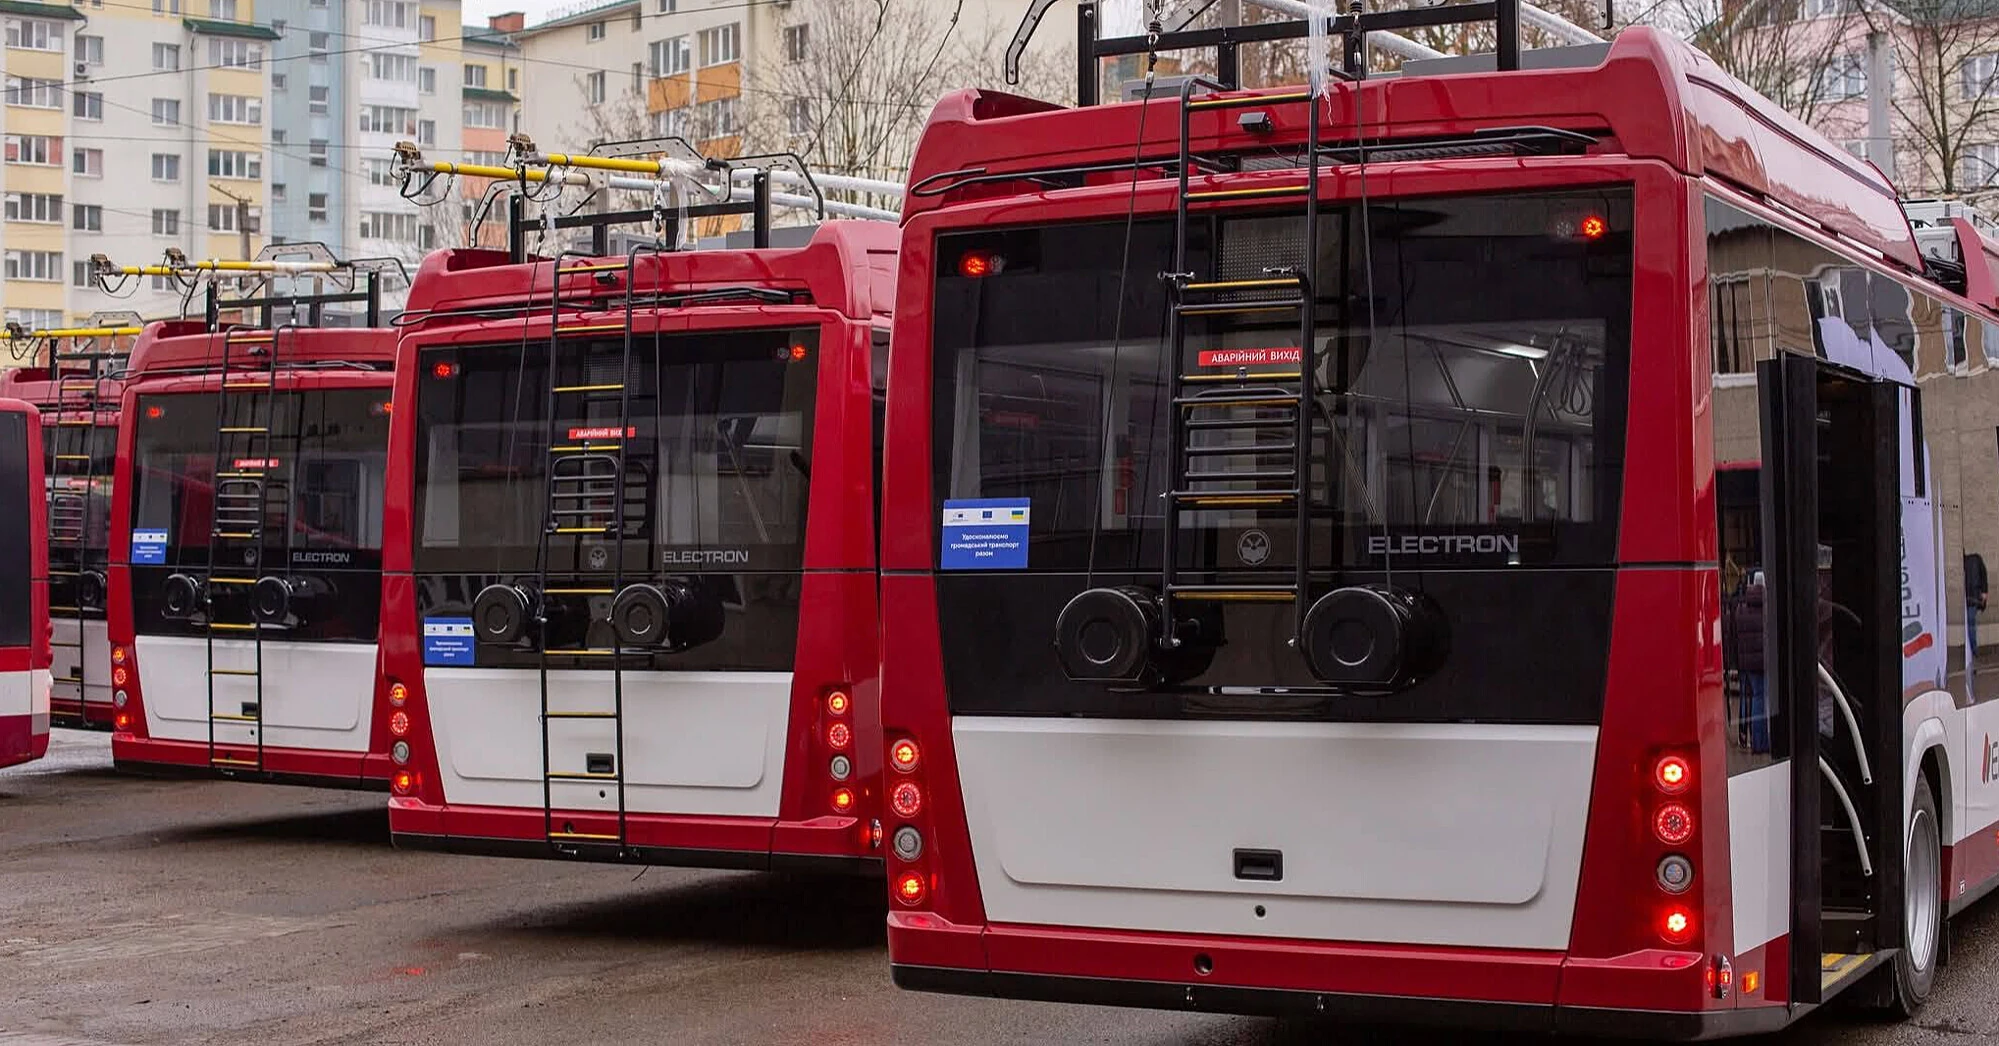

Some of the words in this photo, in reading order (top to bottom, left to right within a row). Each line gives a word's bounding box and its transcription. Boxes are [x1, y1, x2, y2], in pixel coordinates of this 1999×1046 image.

[1211, 349, 1266, 363] АВАРІЙНИЙ
[1270, 350, 1299, 362] ВИХІД
[1368, 534, 1519, 554] ELECTRON
[292, 552, 350, 562] ELECTRON
[663, 550, 749, 563] ELECTRON
